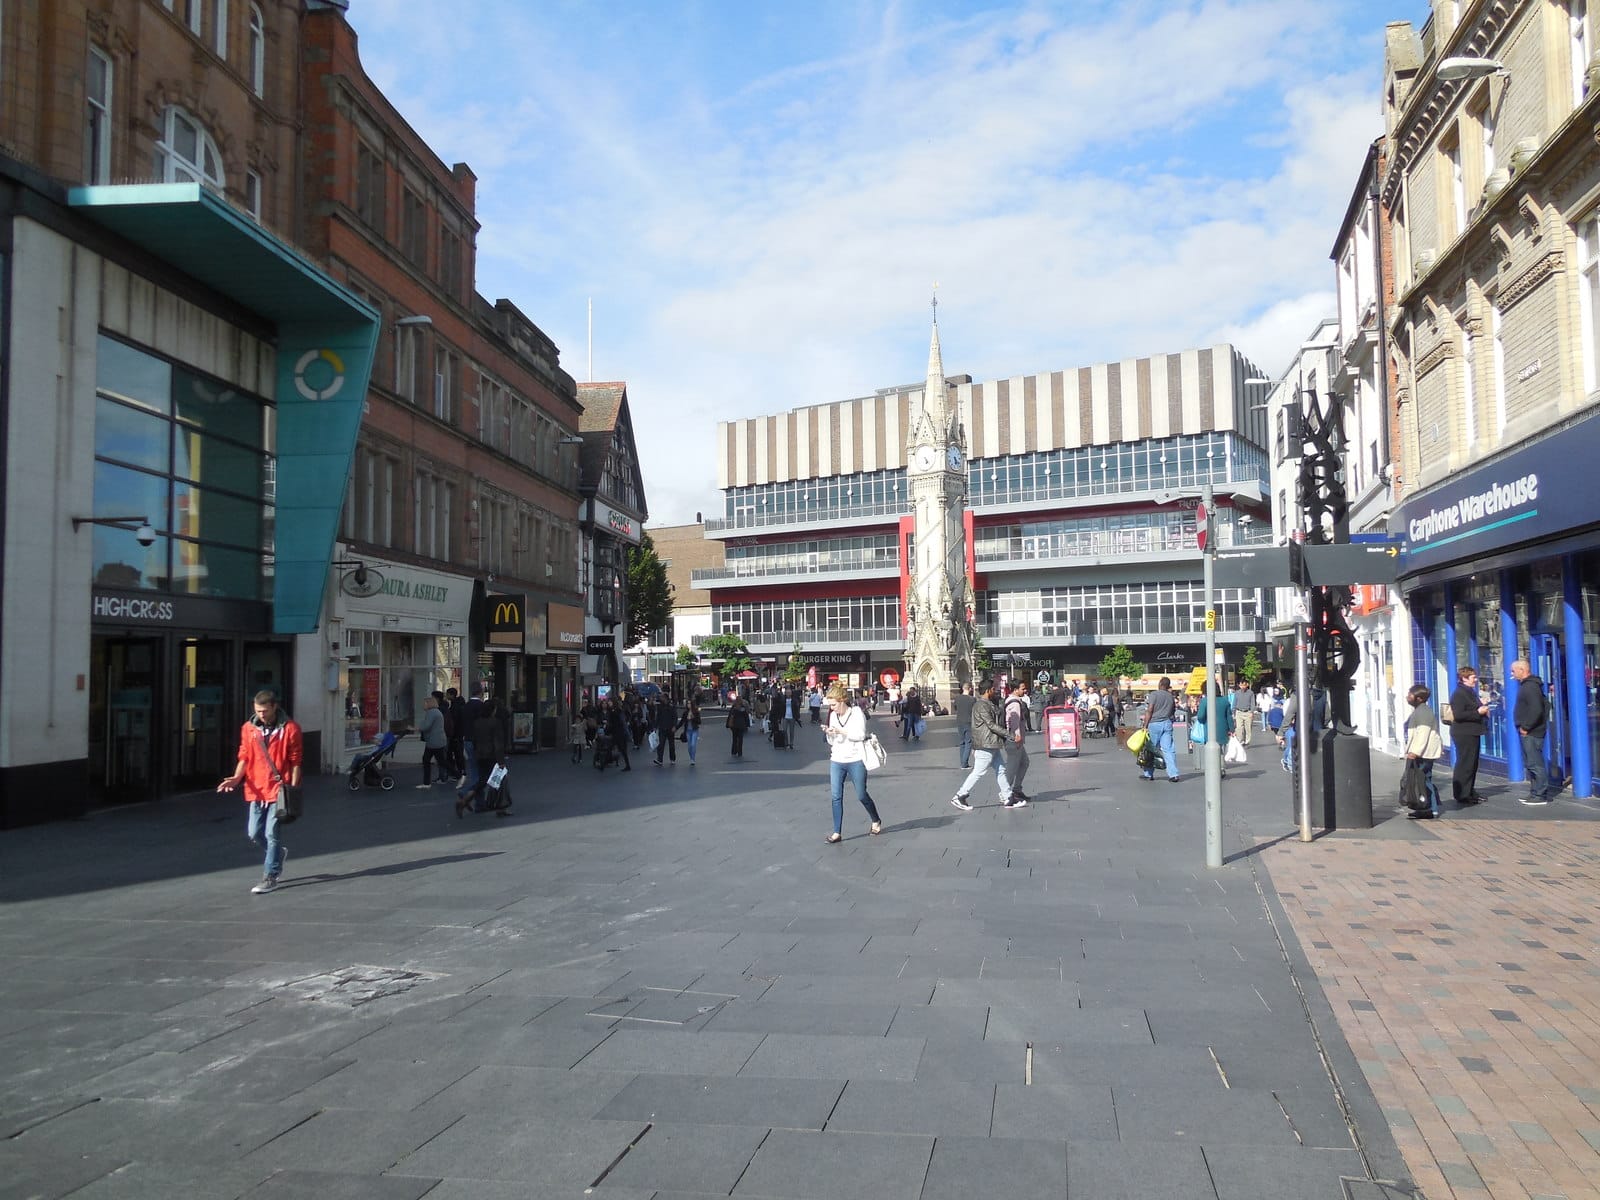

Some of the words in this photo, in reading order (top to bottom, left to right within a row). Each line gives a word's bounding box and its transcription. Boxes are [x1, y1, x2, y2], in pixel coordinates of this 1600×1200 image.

[1409, 505, 1459, 541] Carphone
[1458, 473, 1538, 524] Warehouse
[412, 584, 448, 602] ASHLEY
[94, 596, 173, 620] HIGHCROSS
[1207, 621, 1214, 629] 2
[798, 655, 830, 663] BURGER
[831, 655, 852, 663] KING
[1157, 651, 1185, 660] Clarks
